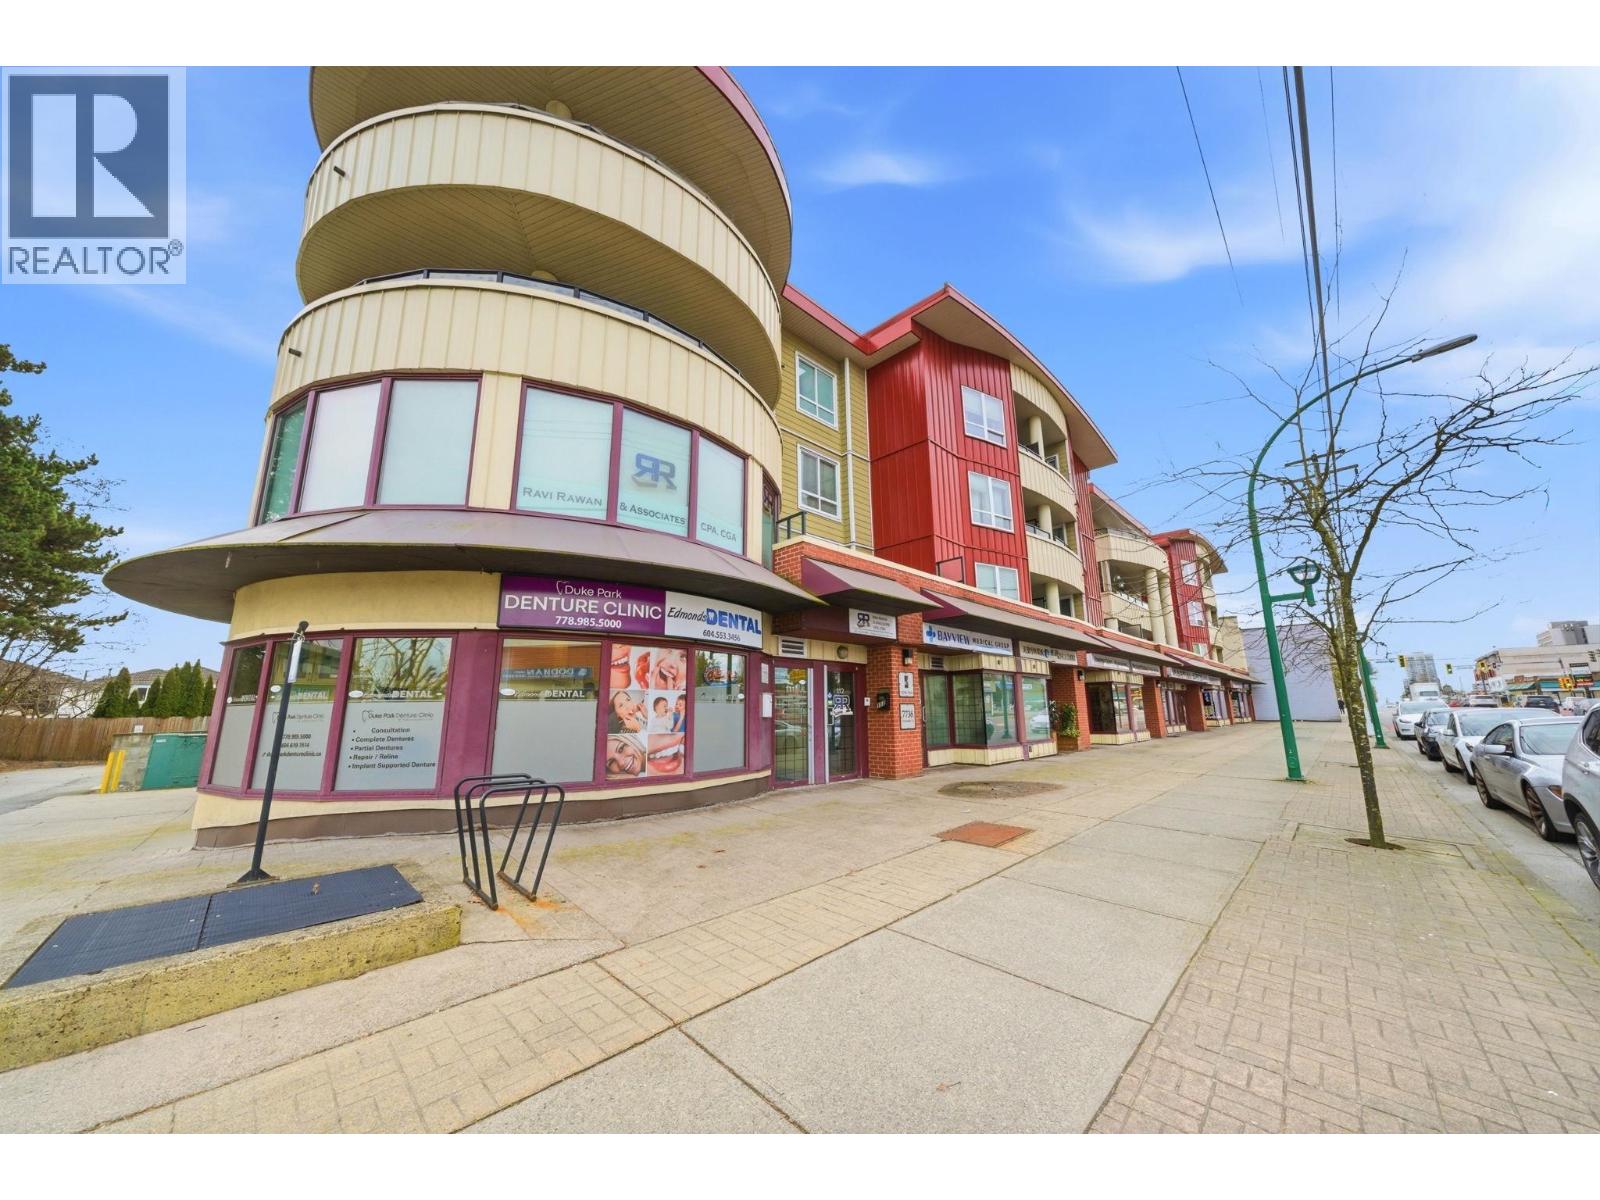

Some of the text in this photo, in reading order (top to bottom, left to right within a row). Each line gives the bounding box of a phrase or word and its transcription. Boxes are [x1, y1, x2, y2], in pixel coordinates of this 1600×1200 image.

[557, 491, 603, 507] RAWAN
[620, 502, 687, 526] & ASSOCIATES
[564, 585, 622, 599] Duke Park
[504, 594, 662, 620] DENTURE CLINIC
[555, 616, 622, 629] 778.985.5000
[937, 630, 970, 645] BAYVIEW
[544, 689, 585, 698] DENTAL
[352, 762, 376, 770] Implant
